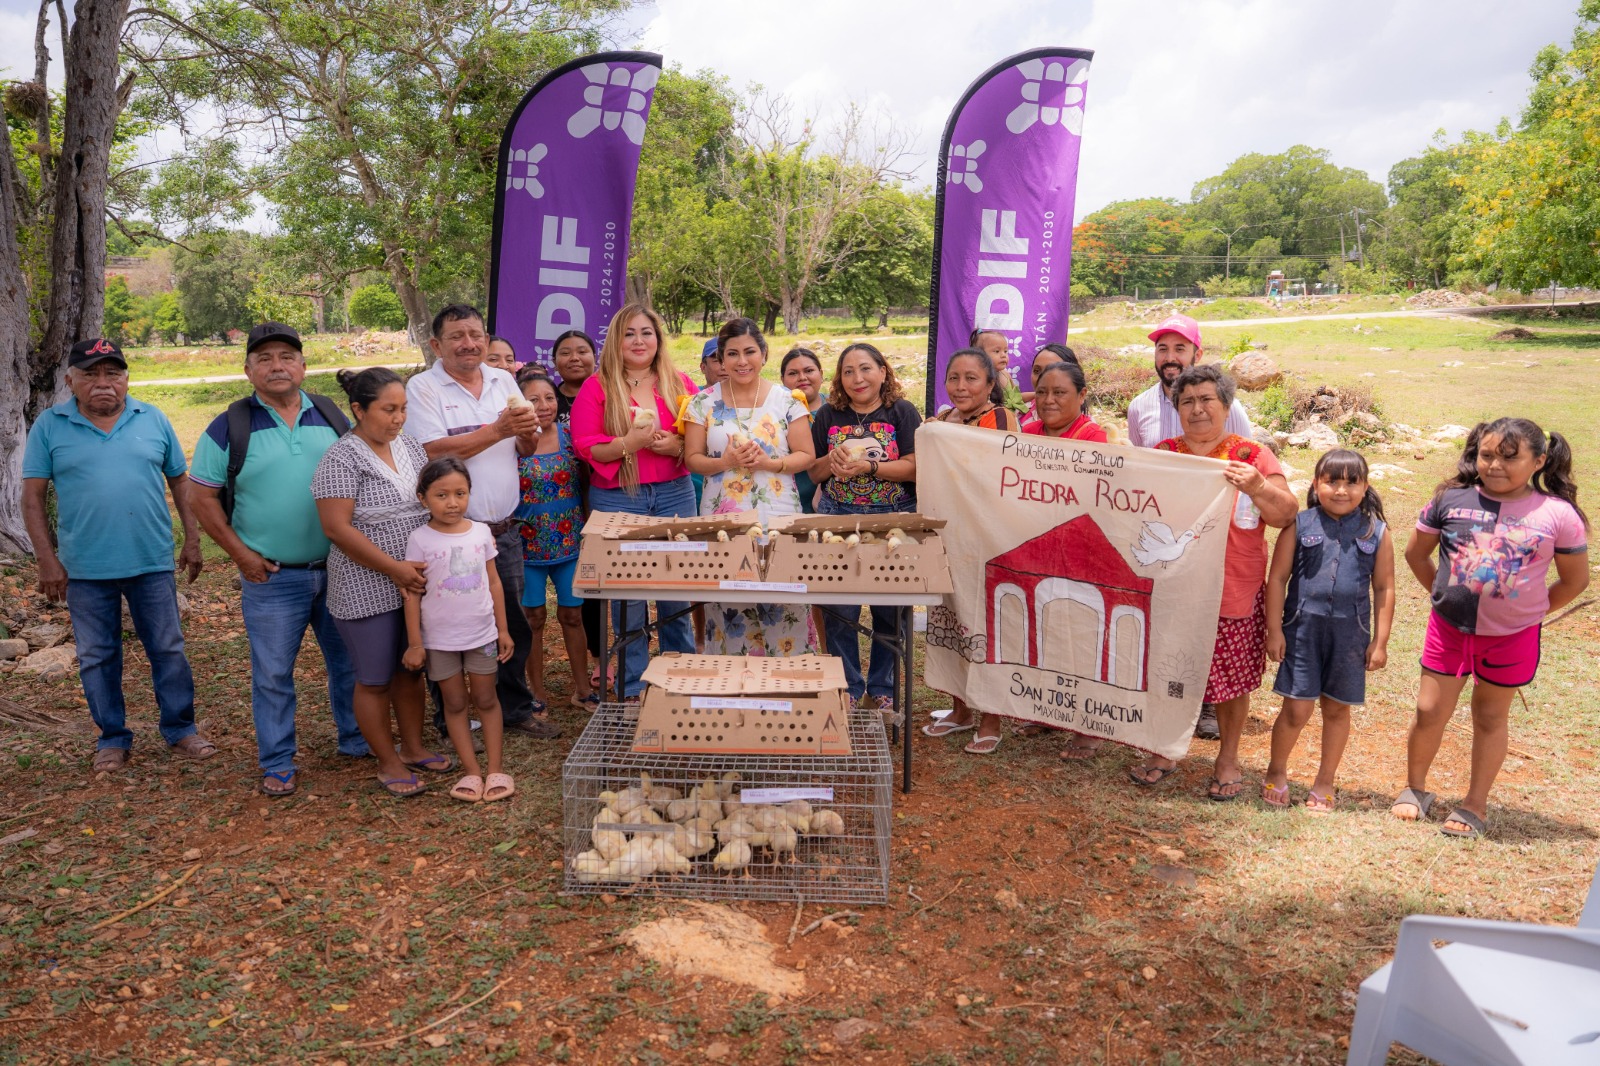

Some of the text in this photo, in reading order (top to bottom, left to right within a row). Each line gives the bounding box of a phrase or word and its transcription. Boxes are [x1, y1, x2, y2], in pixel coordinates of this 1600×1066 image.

[535, 214, 591, 341] DIF
[975, 208, 1030, 331] DIF
[1071, 449, 1085, 464] DE
[1000, 466, 1162, 517] PIEDRA ROJA
[1446, 507, 1498, 522] KEEP
[1010, 672, 1042, 701] SAN
[1056, 675, 1080, 688] DIF
